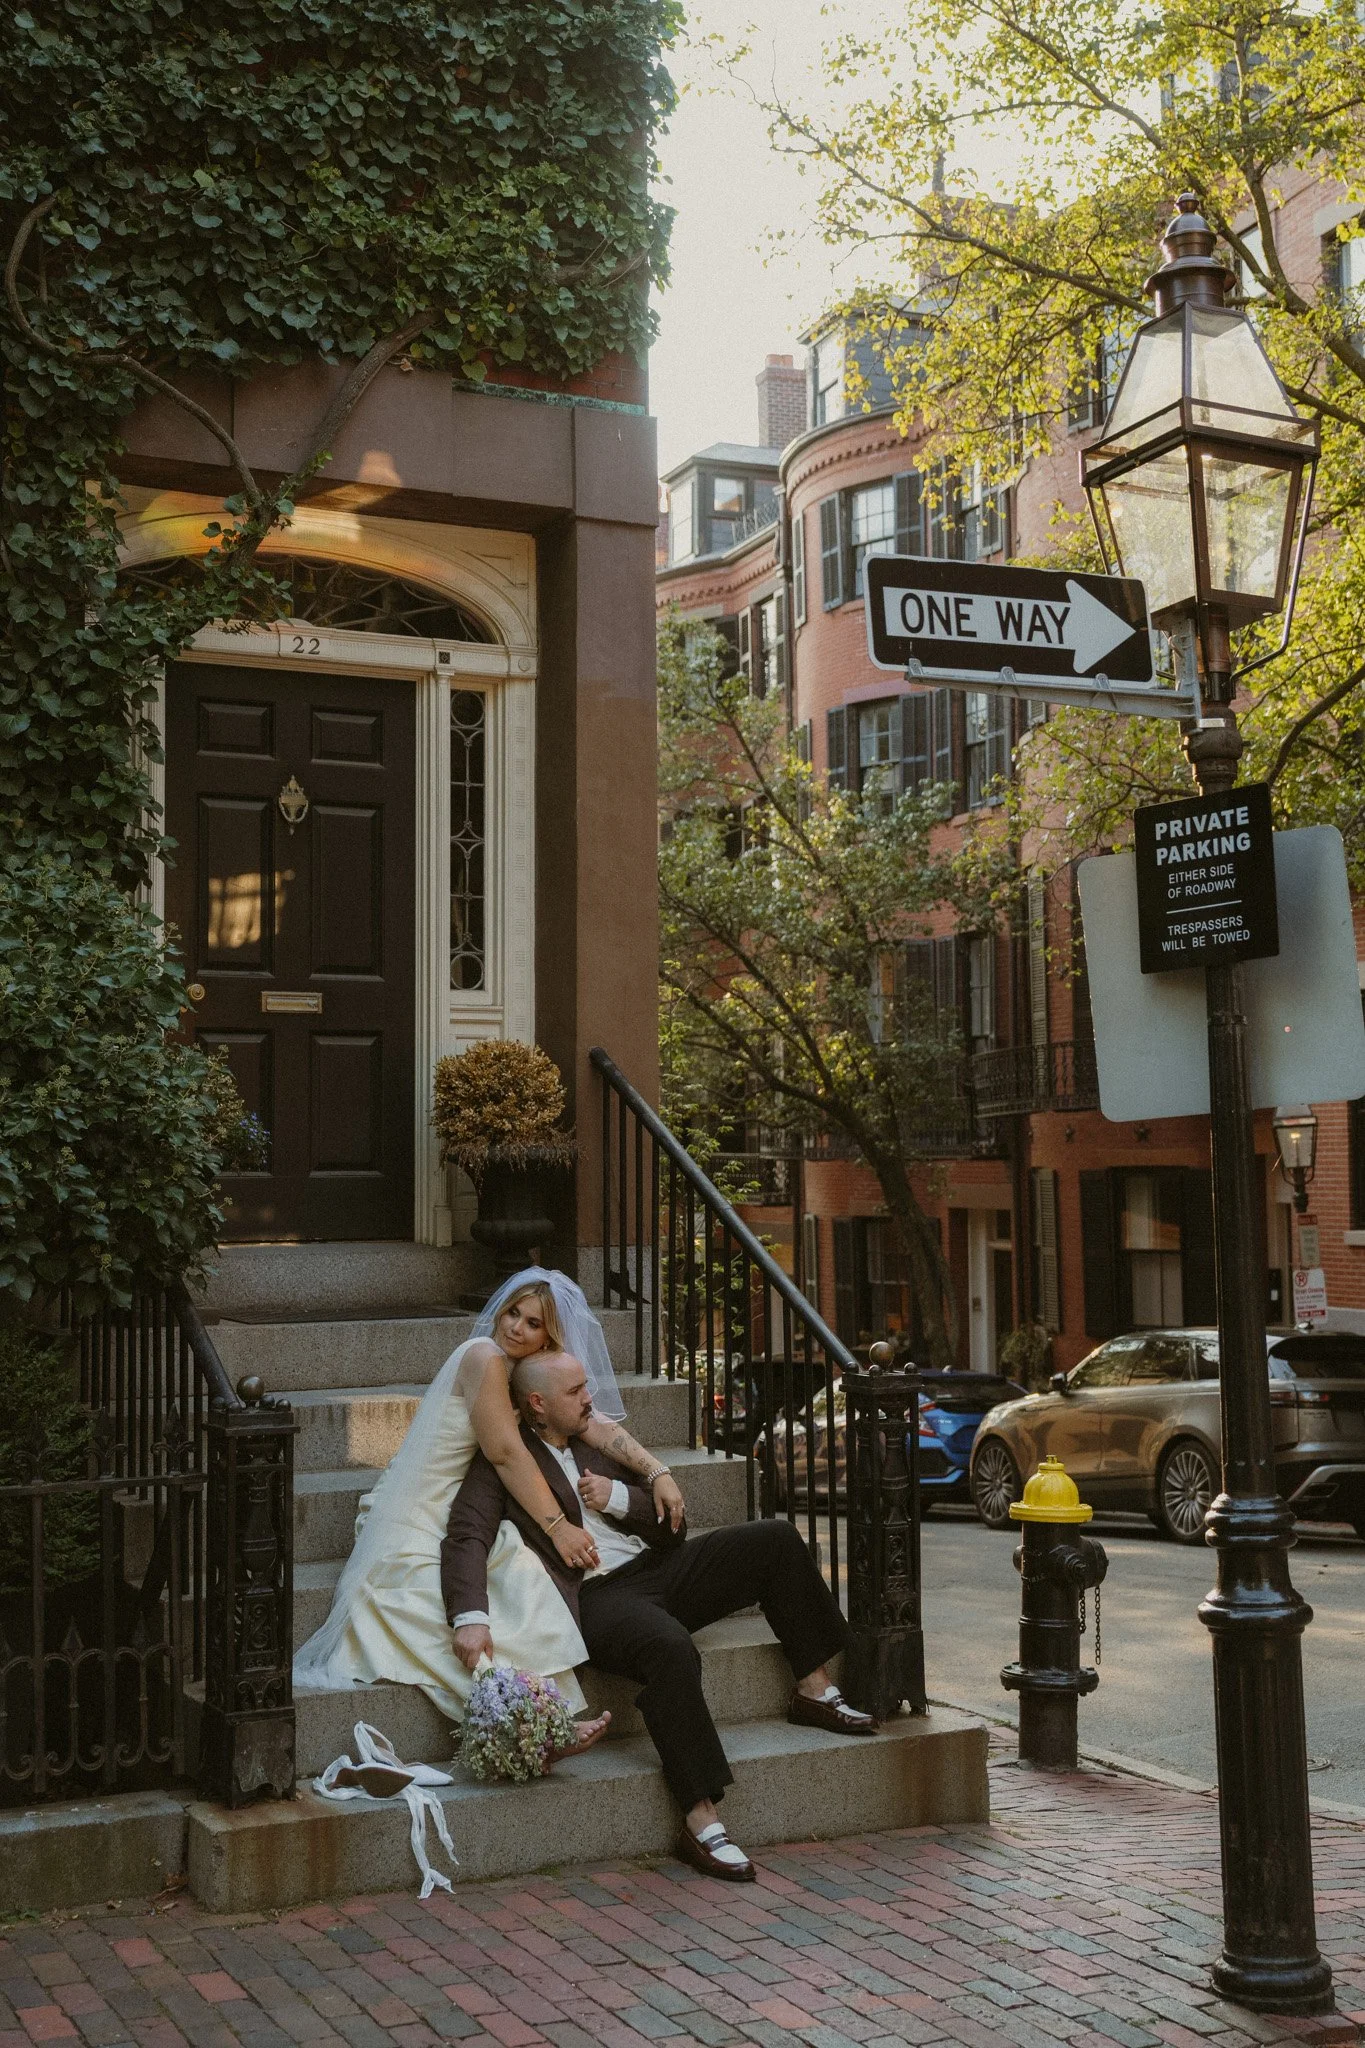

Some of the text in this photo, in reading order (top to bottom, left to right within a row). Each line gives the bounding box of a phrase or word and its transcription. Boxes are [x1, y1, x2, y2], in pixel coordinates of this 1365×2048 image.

[900, 592, 1071, 645] ONE WAY
[292, 636, 321, 655] 22
[1155, 806, 1250, 841] PRIVATE
[1156, 832, 1251, 866] PARKING
[1168, 863, 1234, 884] EITHER SIDE
[1167, 878, 1237, 899] OF ROADWAY
[1167, 915, 1243, 936] TRESPASSERS
[1161, 929, 1250, 952] WILL BE TOWED
